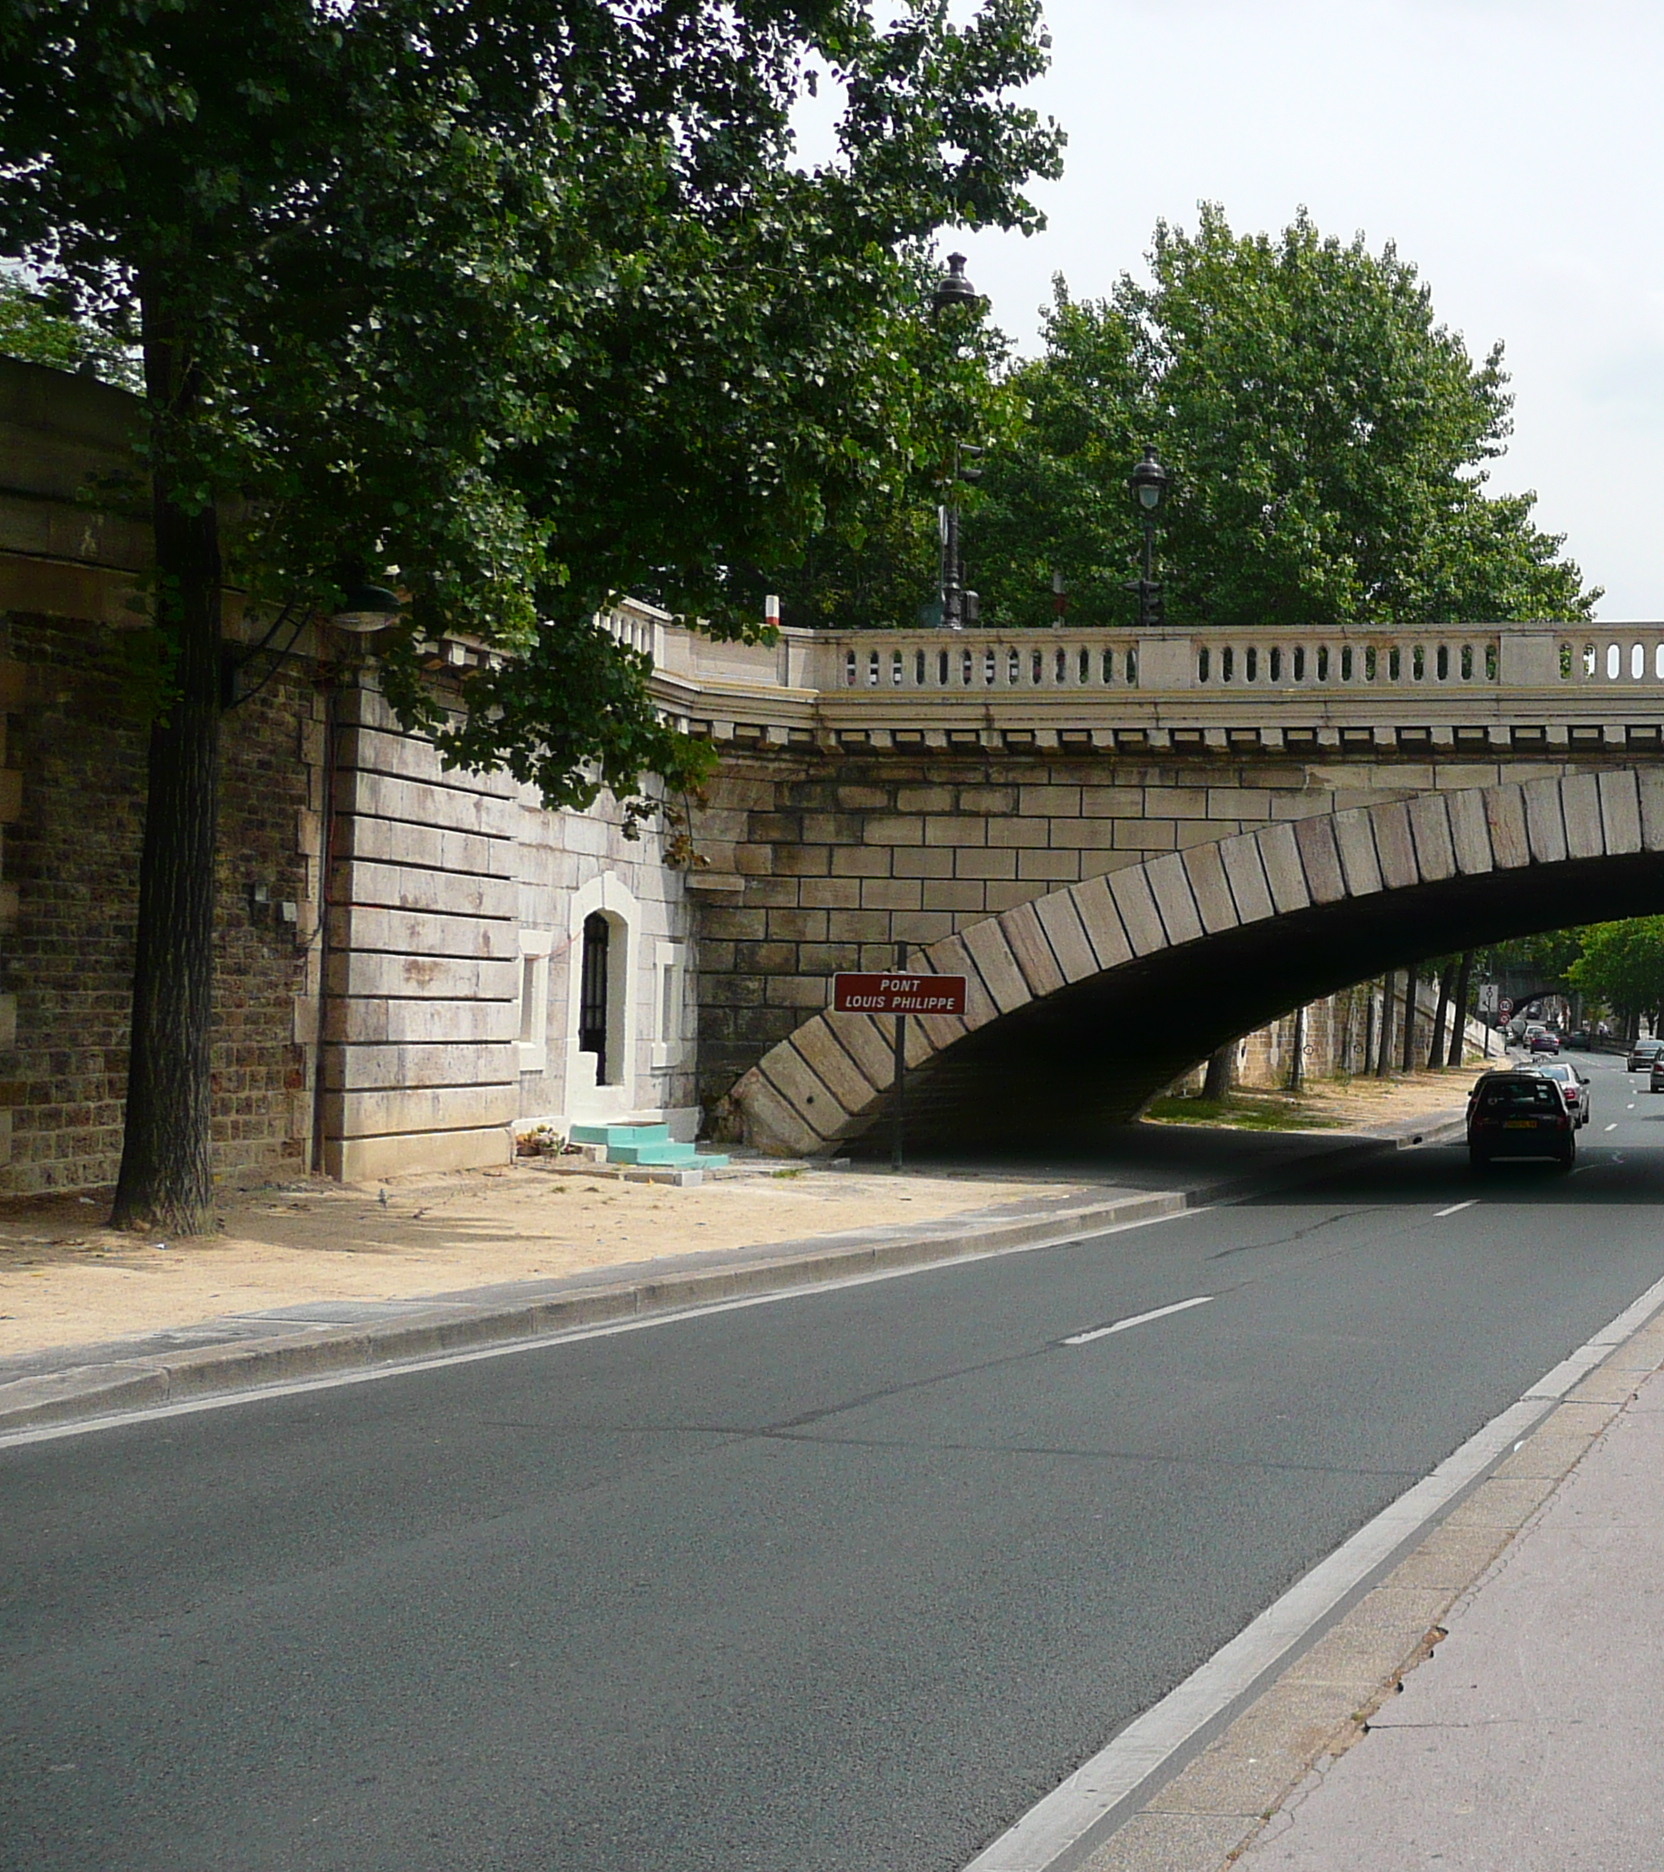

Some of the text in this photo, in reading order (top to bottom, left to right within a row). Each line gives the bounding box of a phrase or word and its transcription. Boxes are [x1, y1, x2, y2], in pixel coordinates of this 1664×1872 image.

[880, 979, 921, 992] PONT
[845, 995, 955, 1010] LOUIS PHILIPPE
